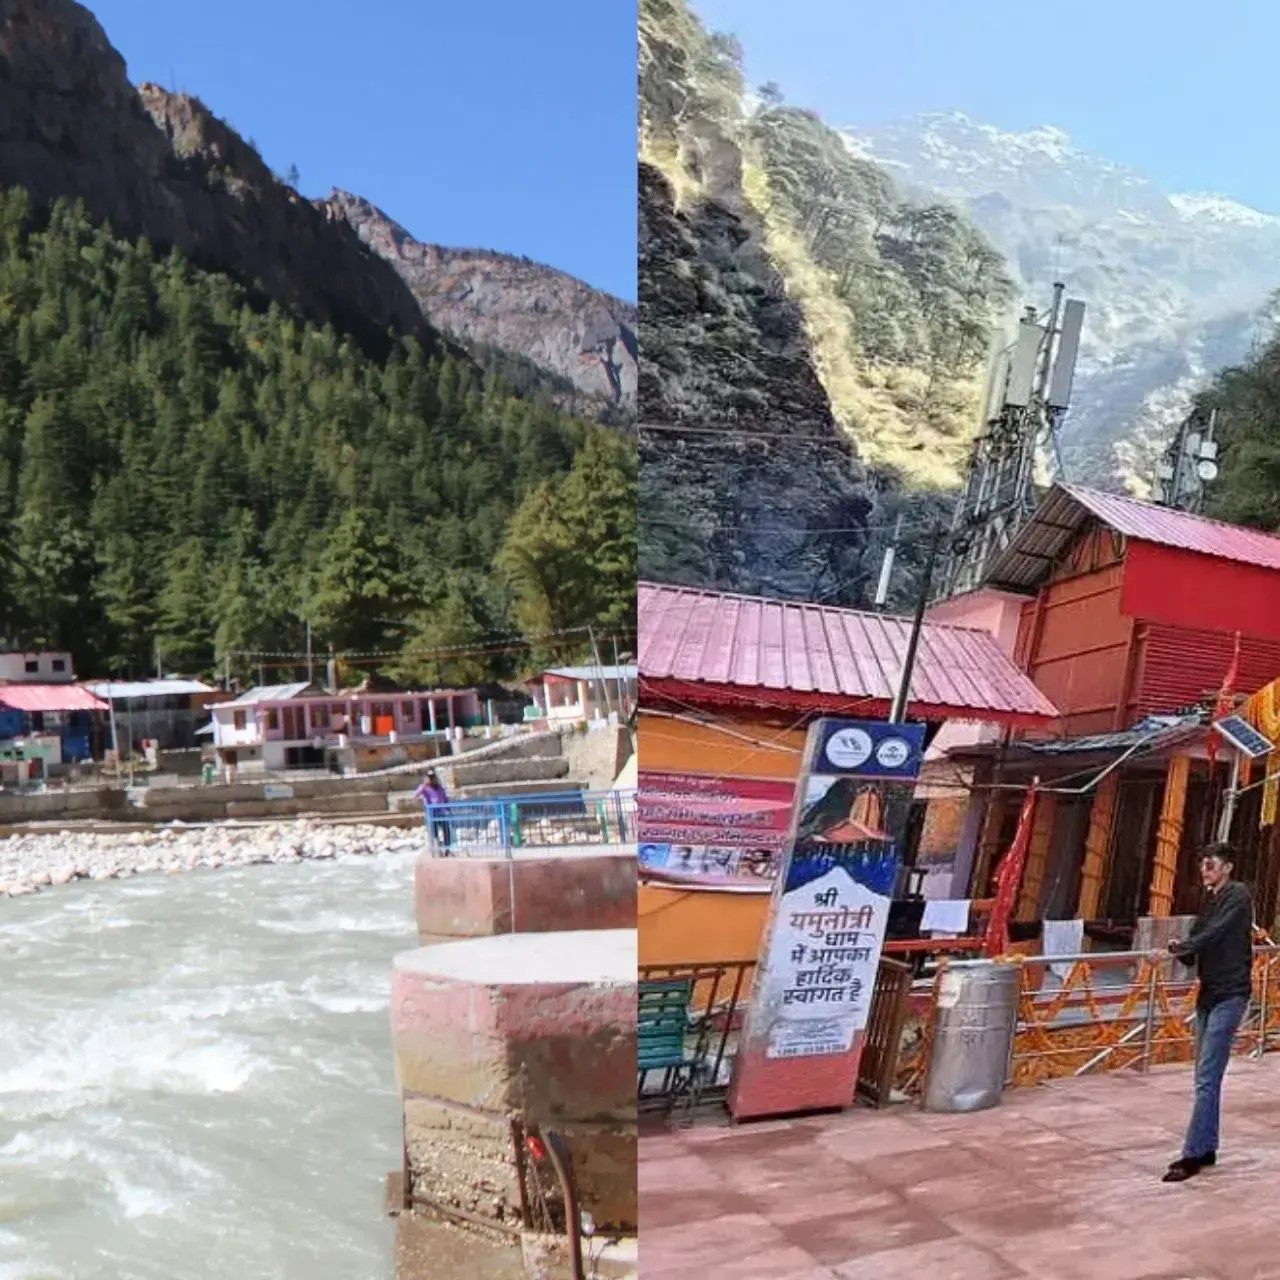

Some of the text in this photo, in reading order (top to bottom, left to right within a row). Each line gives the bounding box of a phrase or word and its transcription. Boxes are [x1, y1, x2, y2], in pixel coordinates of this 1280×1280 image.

[813, 887, 839, 907] श्री
[790, 905, 875, 938] यमुनोत्री
[825, 931, 861, 945] धाम
[791, 943, 873, 964] में आपका
[795, 963, 854, 987] हार्दिक
[783, 978, 863, 1005] स्वागत है
